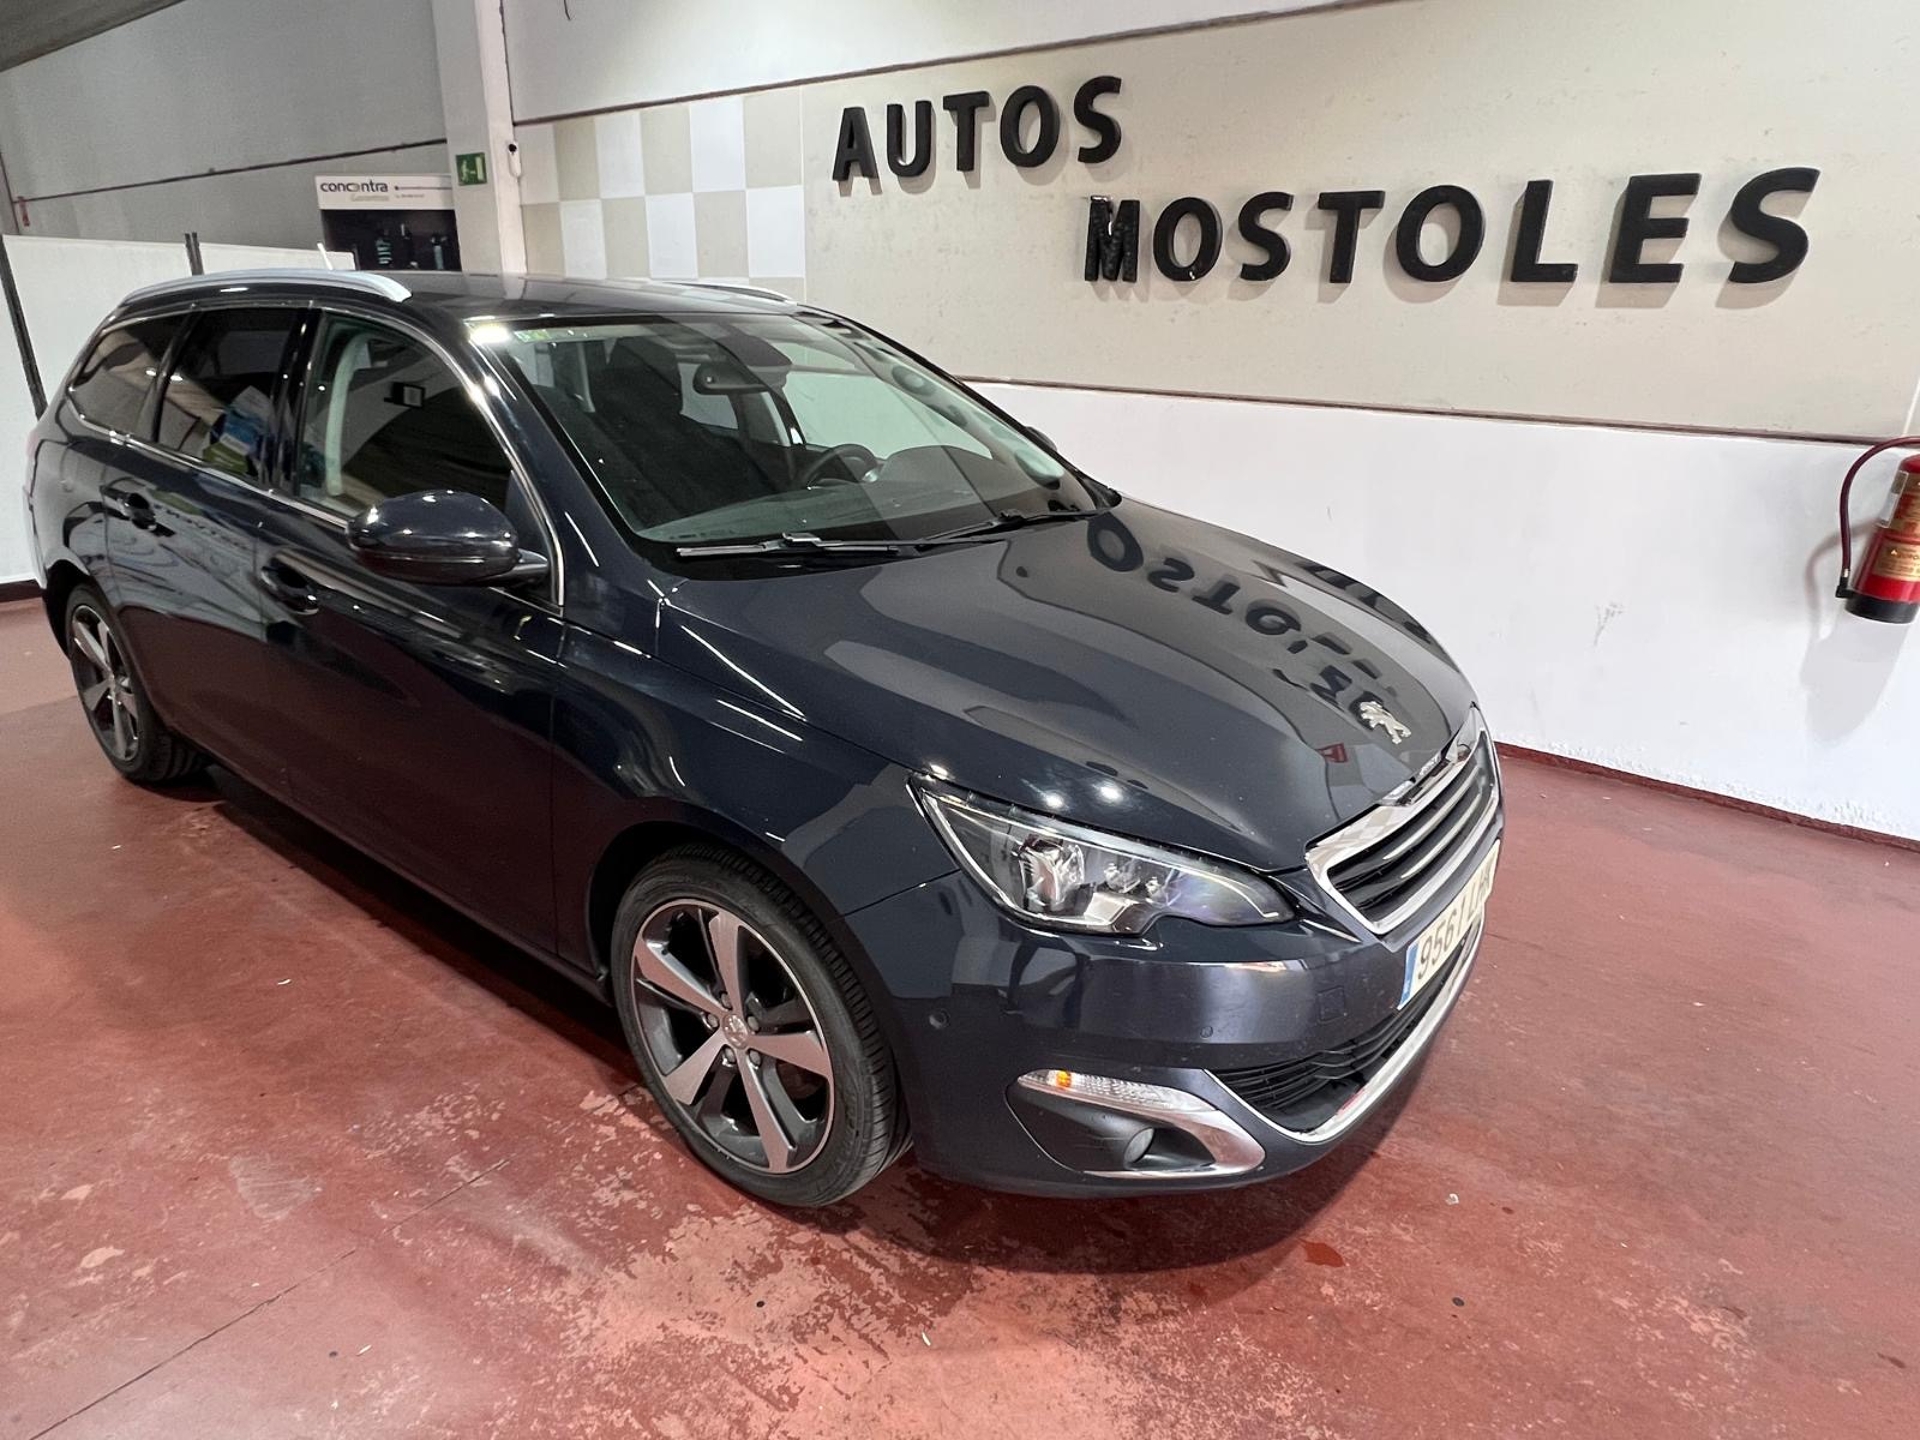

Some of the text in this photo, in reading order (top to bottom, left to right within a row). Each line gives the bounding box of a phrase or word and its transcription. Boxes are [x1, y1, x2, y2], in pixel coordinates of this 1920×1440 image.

[832, 75, 1122, 182] AUTOS
[320, 180, 388, 193] concentra
[1084, 167, 1820, 284] MOSTOLES
